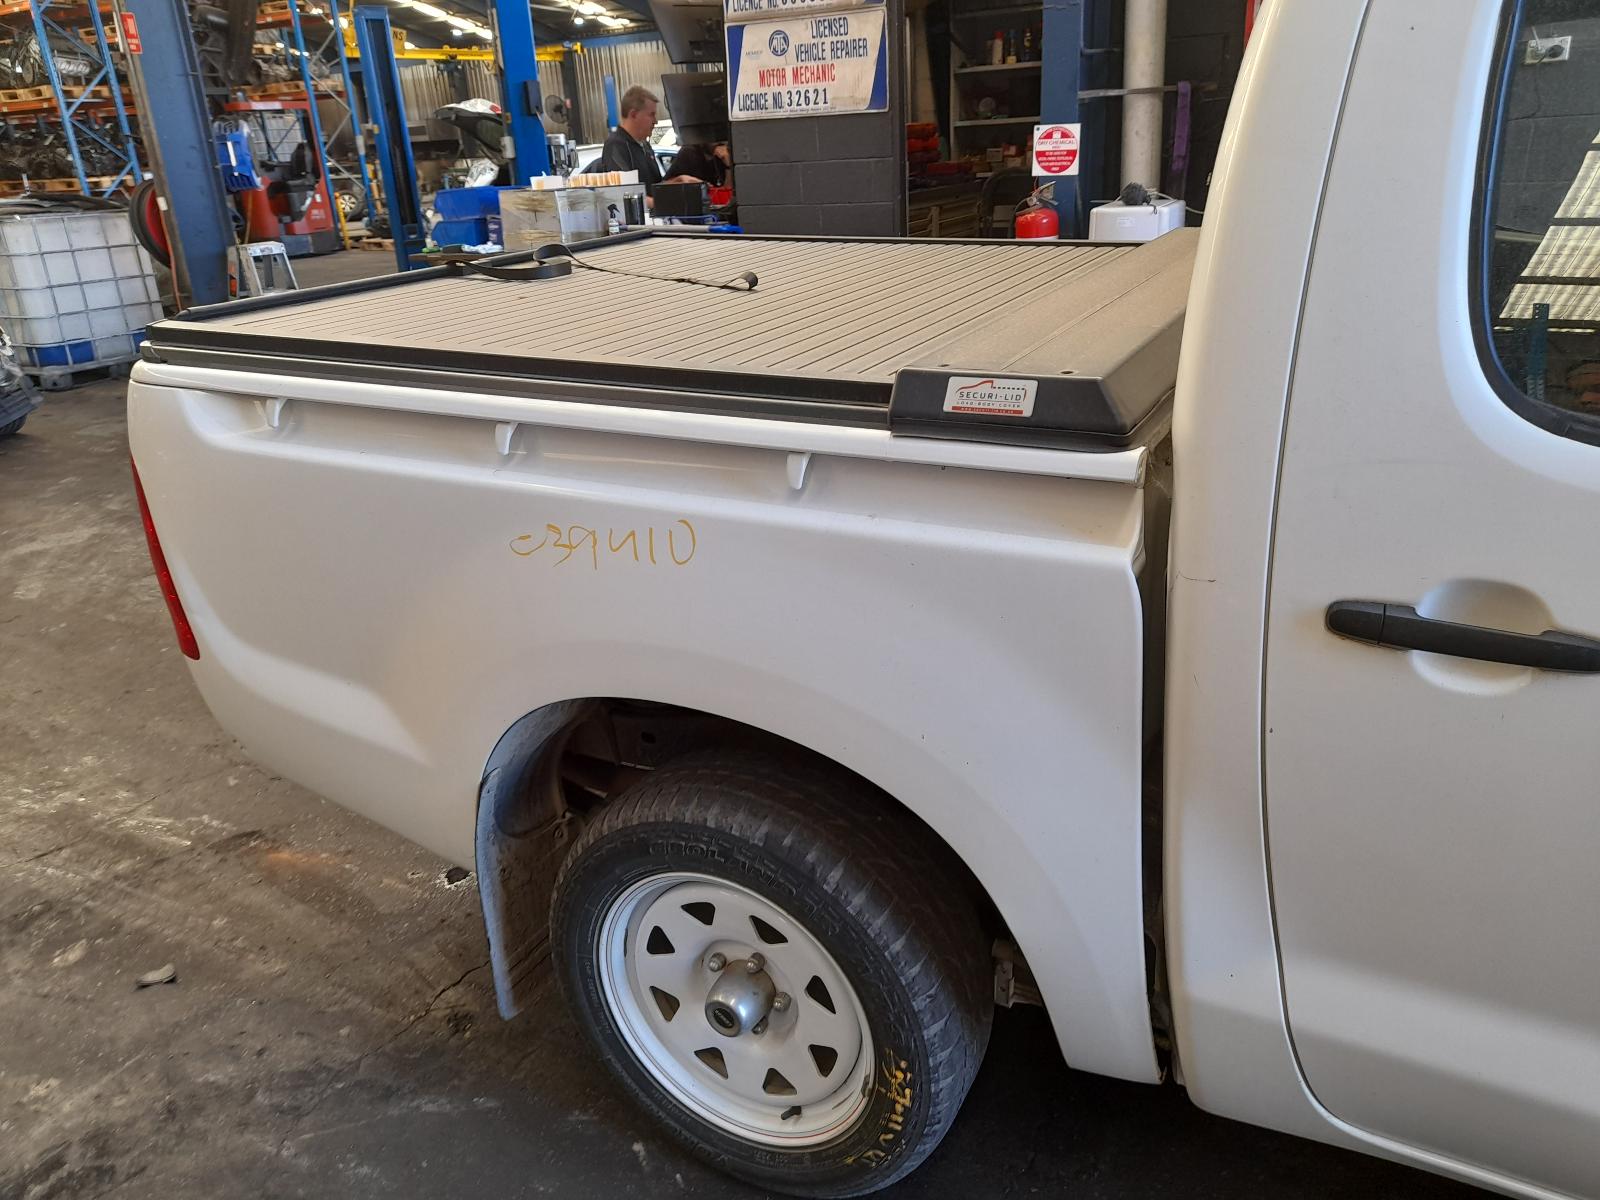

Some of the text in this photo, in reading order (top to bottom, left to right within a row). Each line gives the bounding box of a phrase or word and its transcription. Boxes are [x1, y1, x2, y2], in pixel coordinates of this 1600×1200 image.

[810, 16, 849, 39] LICENSED
[795, 38, 868, 63] VEHICLE REPAIRER
[759, 63, 836, 88] MOTOR MECHANIC
[738, 93, 768, 112] LICENCE
[772, 91, 784, 110] NO.
[787, 88, 829, 108] 32621
[959, 391, 1022, 401] SECURI-LID
